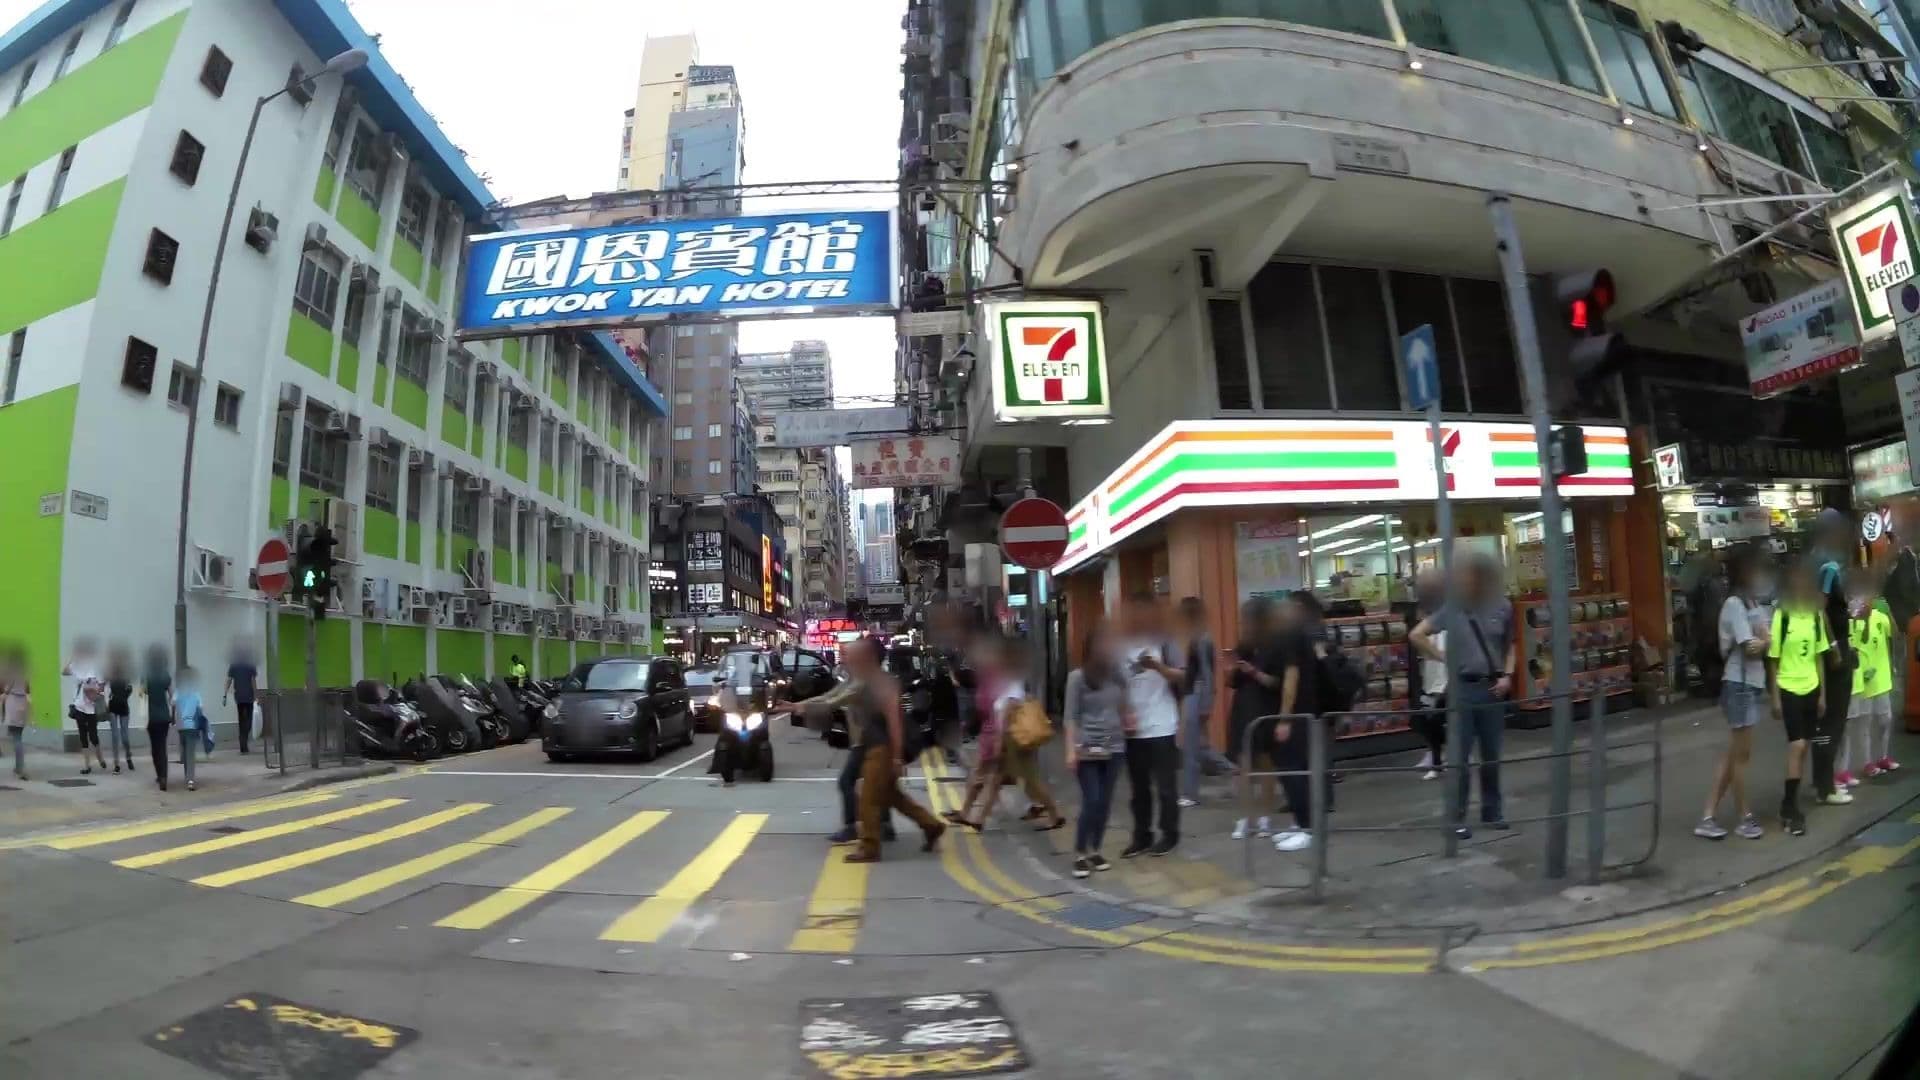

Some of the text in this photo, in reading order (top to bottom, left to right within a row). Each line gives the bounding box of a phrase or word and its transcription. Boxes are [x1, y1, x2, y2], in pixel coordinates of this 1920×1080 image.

[486, 219, 863, 296] 國恩賓館
[492, 278, 851, 319] KWOK YAN HOTEL
[1022, 326, 1077, 402] 7
